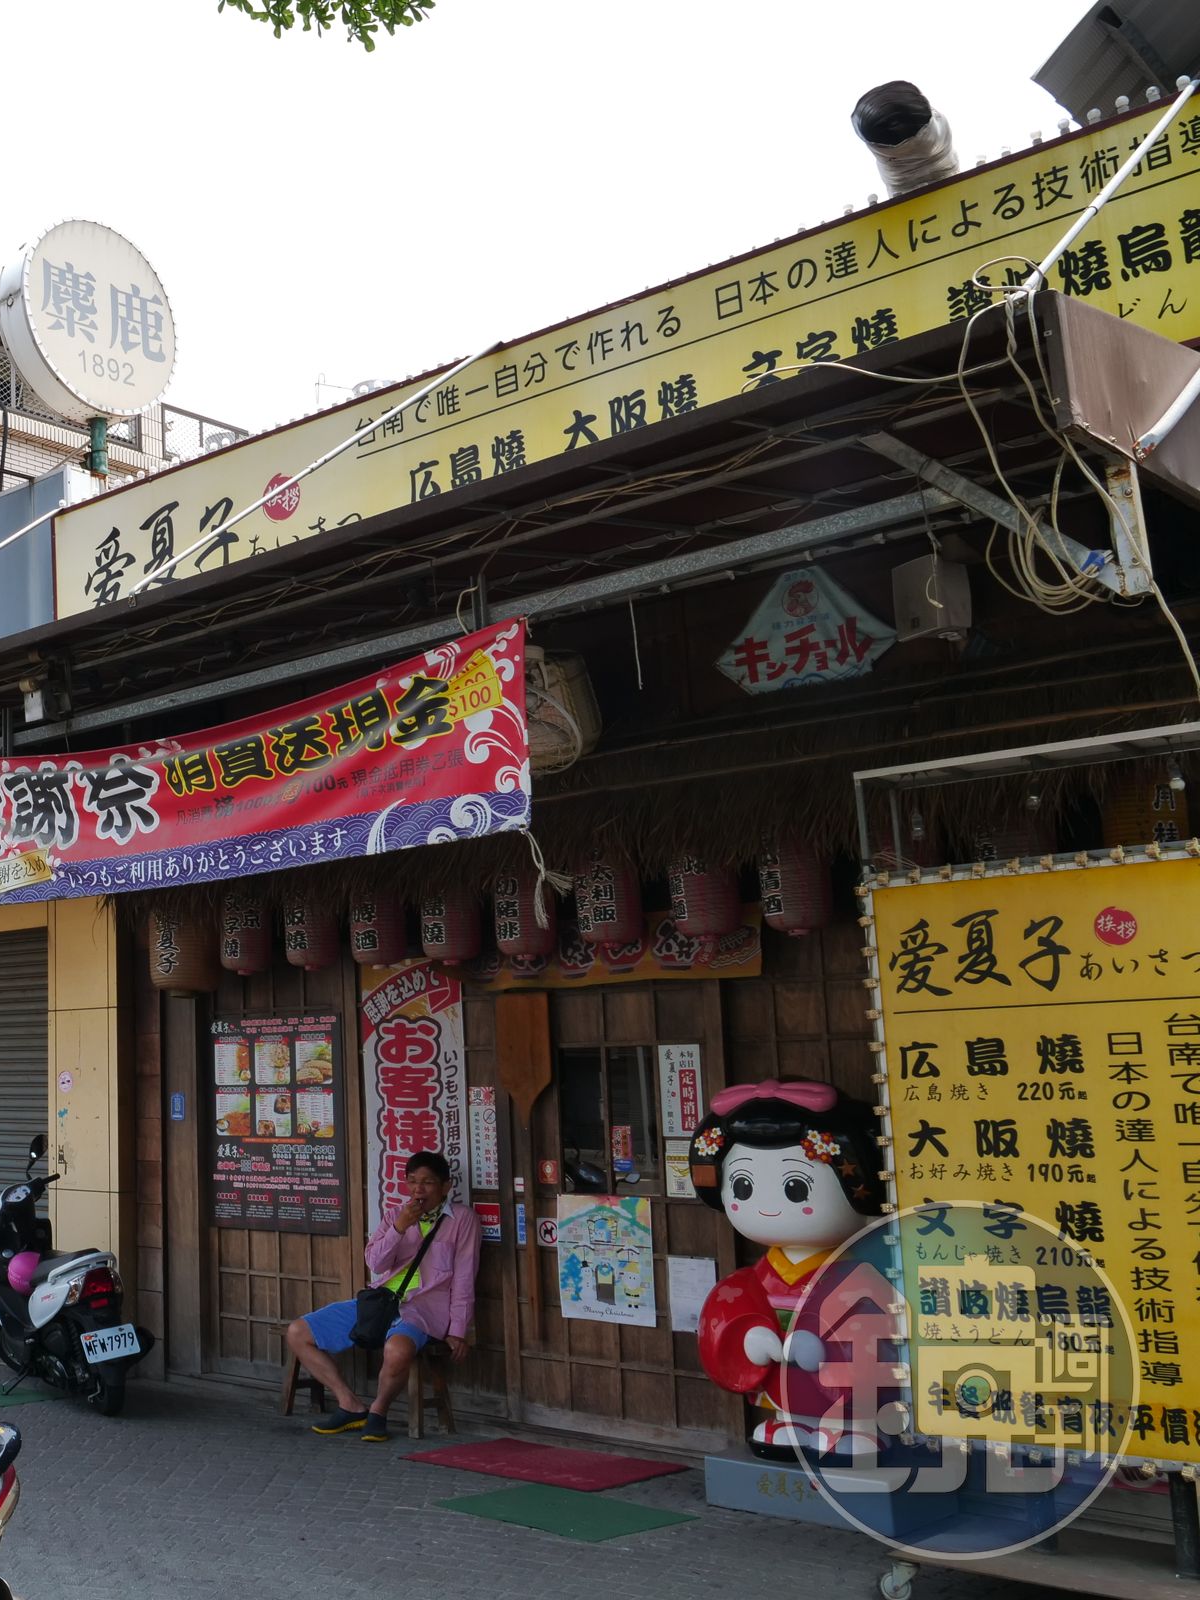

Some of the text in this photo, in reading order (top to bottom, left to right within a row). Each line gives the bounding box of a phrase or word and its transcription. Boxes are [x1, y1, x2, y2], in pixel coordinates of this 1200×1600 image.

[41, 257, 166, 363] 麋鹿
[78, 350, 136, 387] 1892
[68, 828, 348, 890] いつもご利用ありがとうございます
[285, 897, 308, 951] 阪燒
[888, 908, 1072, 997] 愛夏子
[1079, 948, 1200, 982] あいさつ
[899, 1033, 1085, 1080] 広島燒
[903, 1083, 991, 1102] 広島焼き
[907, 1117, 1096, 1159] 大阪燒
[908, 1162, 1014, 1183] お好み焼き
[1106, 1031, 1184, 1388] 日本の達人による技術指導
[84, 1331, 135, 1357] MFW-7979
